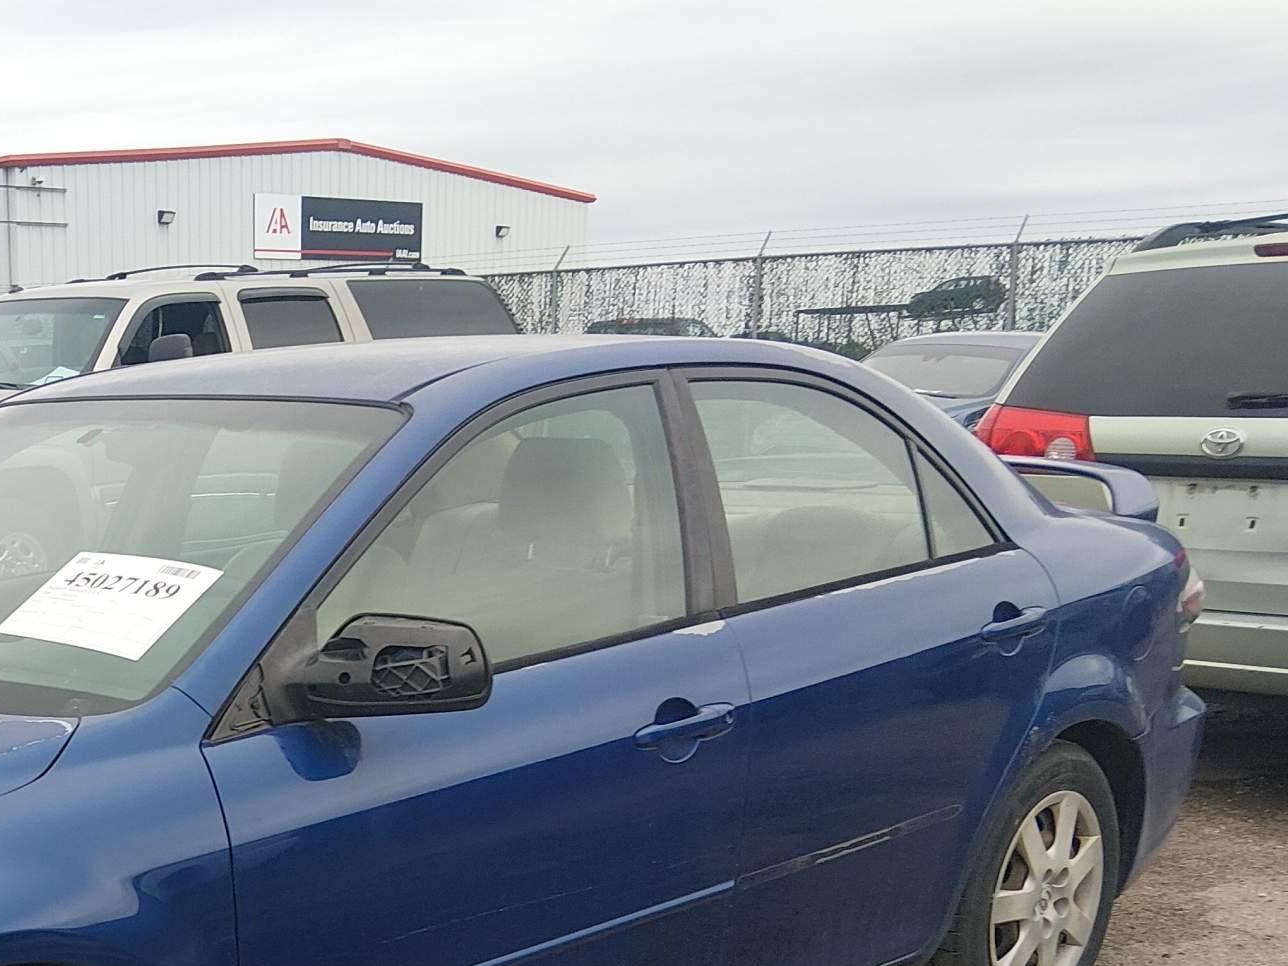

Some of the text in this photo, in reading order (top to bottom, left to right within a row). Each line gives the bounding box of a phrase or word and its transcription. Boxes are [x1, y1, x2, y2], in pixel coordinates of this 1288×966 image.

[309, 215, 415, 236] Insurance Auto Auctions
[64, 571, 181, 600] 45027189
